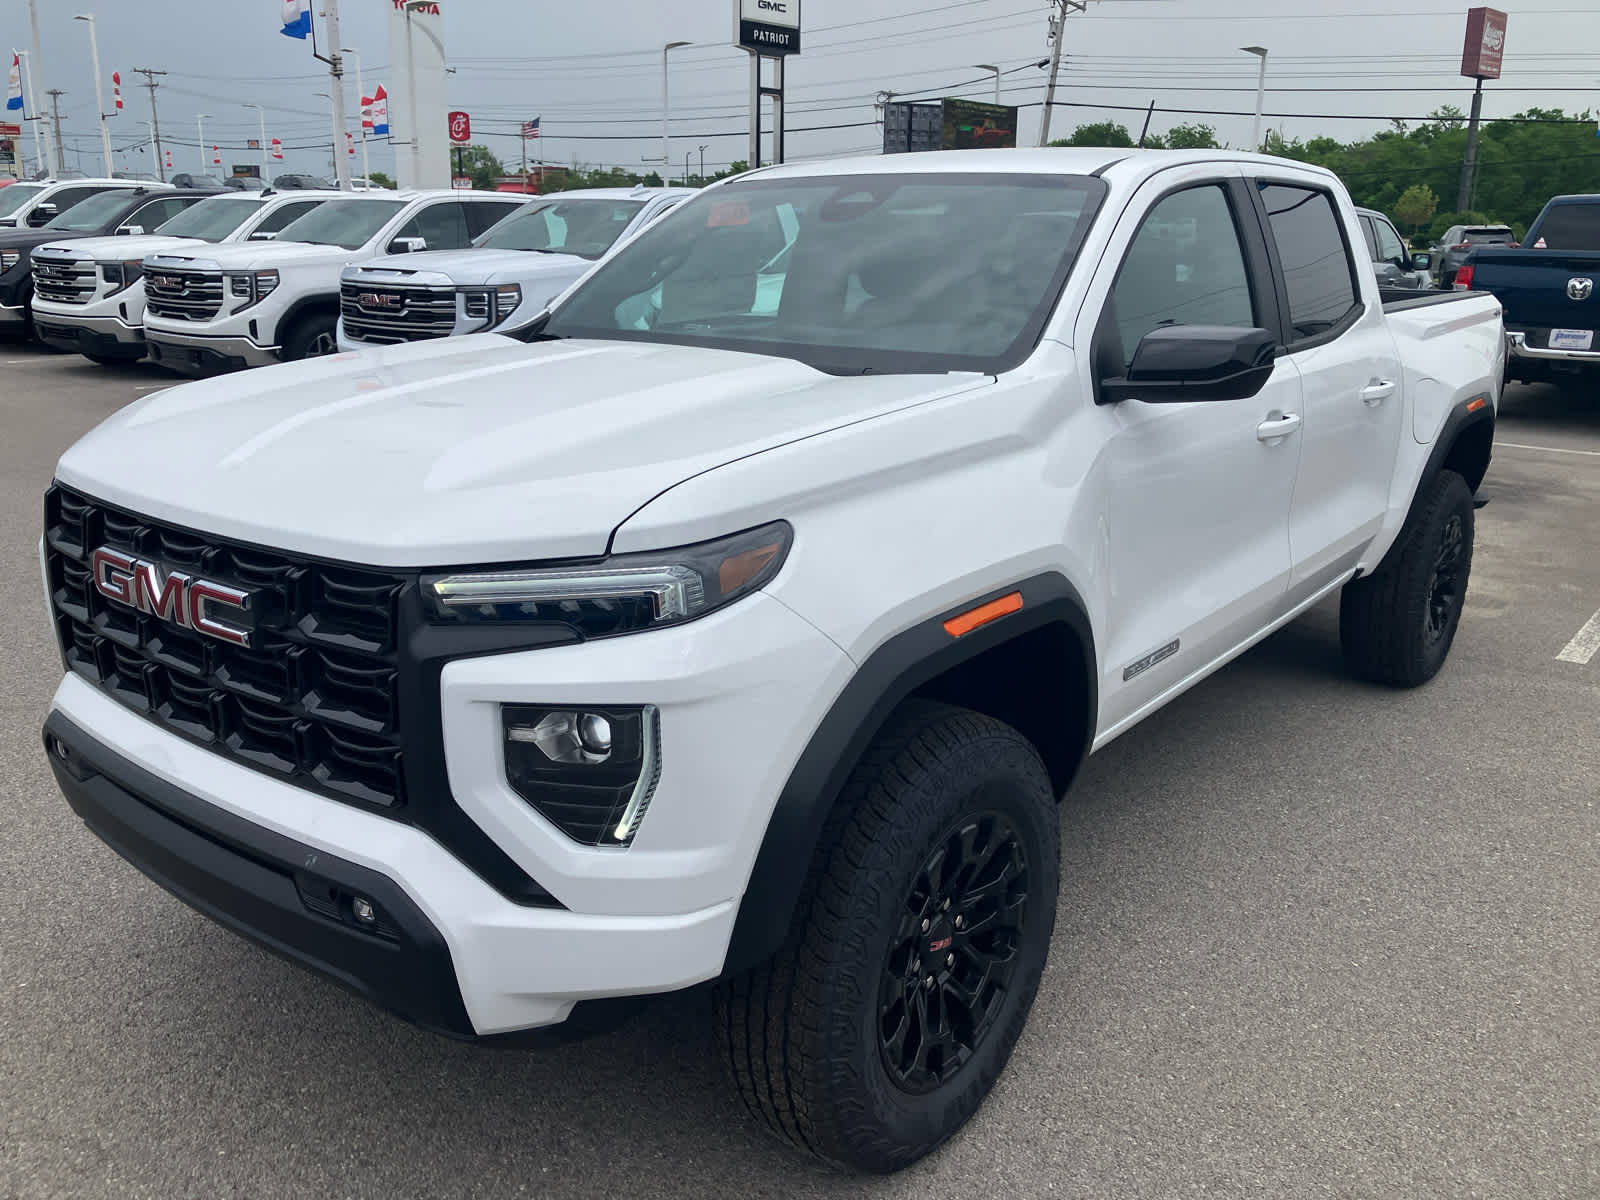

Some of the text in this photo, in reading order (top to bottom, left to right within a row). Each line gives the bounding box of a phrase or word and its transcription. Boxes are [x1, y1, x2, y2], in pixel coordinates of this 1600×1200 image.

[758, 0, 787, 13] GMC
[753, 29, 790, 45] PATRIOT
[359, 293, 401, 309] GMC
[93, 546, 251, 648] GMC
